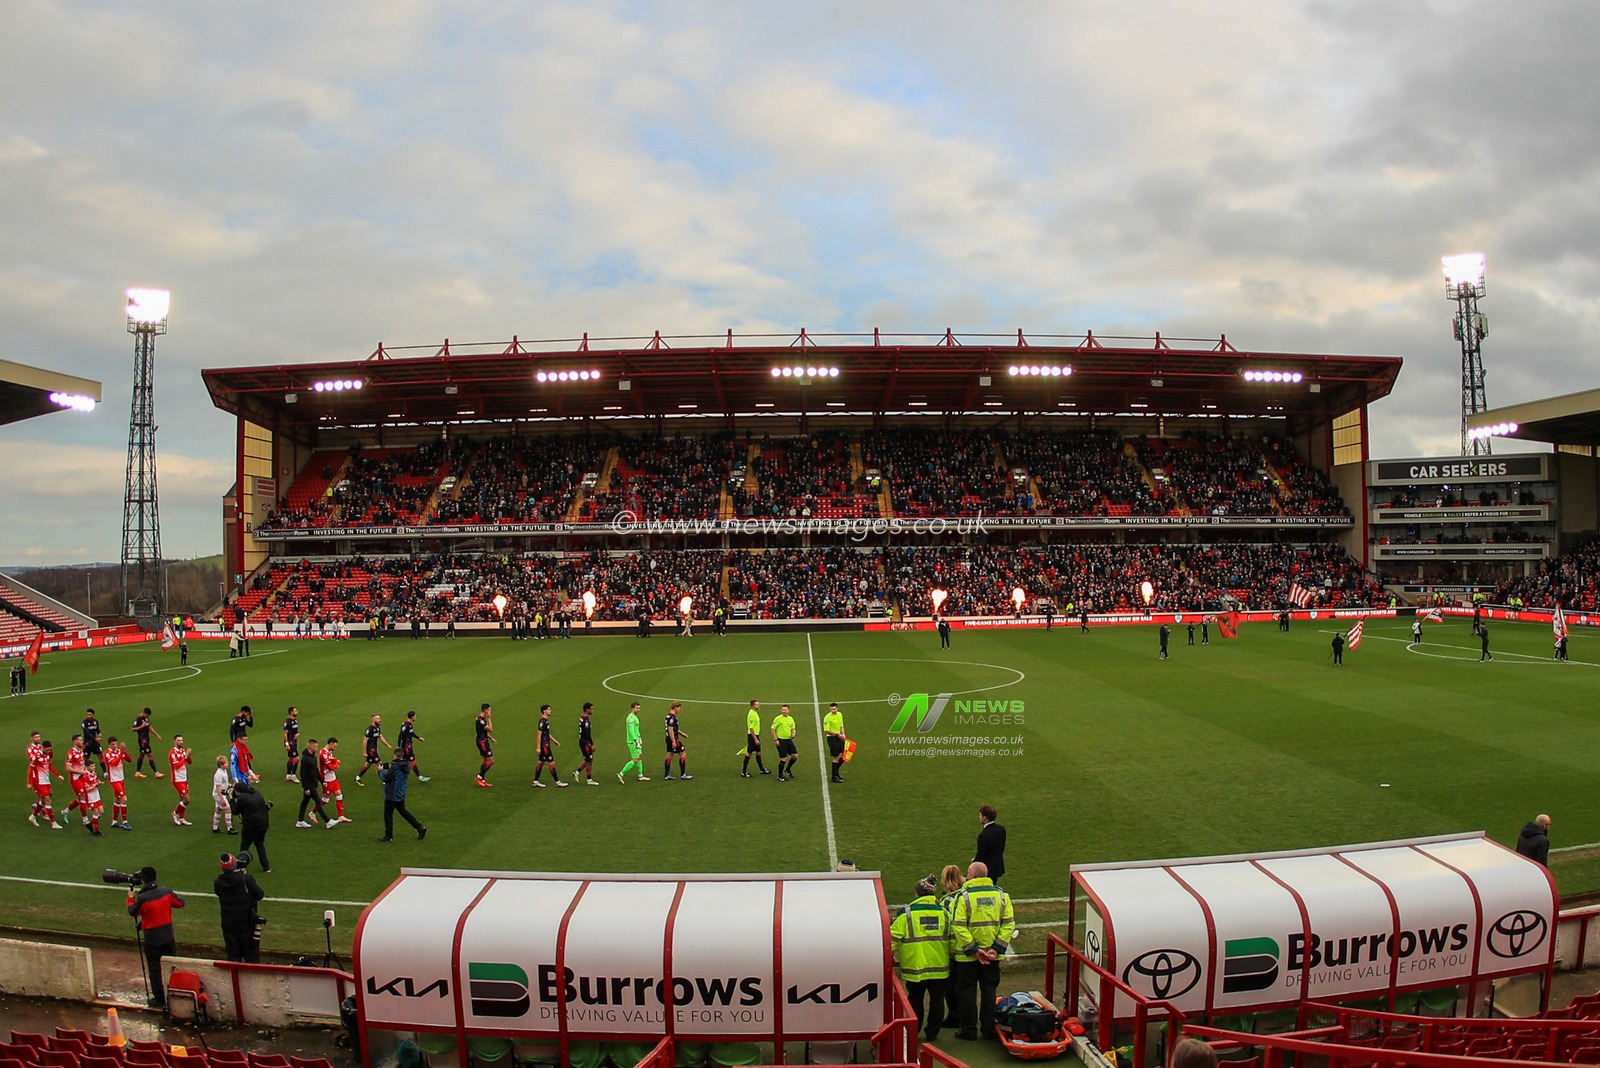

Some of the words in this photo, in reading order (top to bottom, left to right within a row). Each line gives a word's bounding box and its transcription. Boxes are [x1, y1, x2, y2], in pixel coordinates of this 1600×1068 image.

[1409, 465, 1438, 479] CAR
[1442, 461, 1507, 478] SEEKERS
[1287, 923, 1469, 971] Burrows
[537, 964, 764, 1007] Burrows
[1285, 968, 1352, 987] DRIVING
[1357, 964, 1406, 979] VALUE
[1410, 957, 1436, 972] FOR
[1441, 953, 1468, 967] YOU
[540, 1006, 617, 1022] DRIVING
[622, 1010, 685, 1023] VALUE
[691, 1010, 724, 1023] FOR
[730, 1010, 765, 1022] YOU
